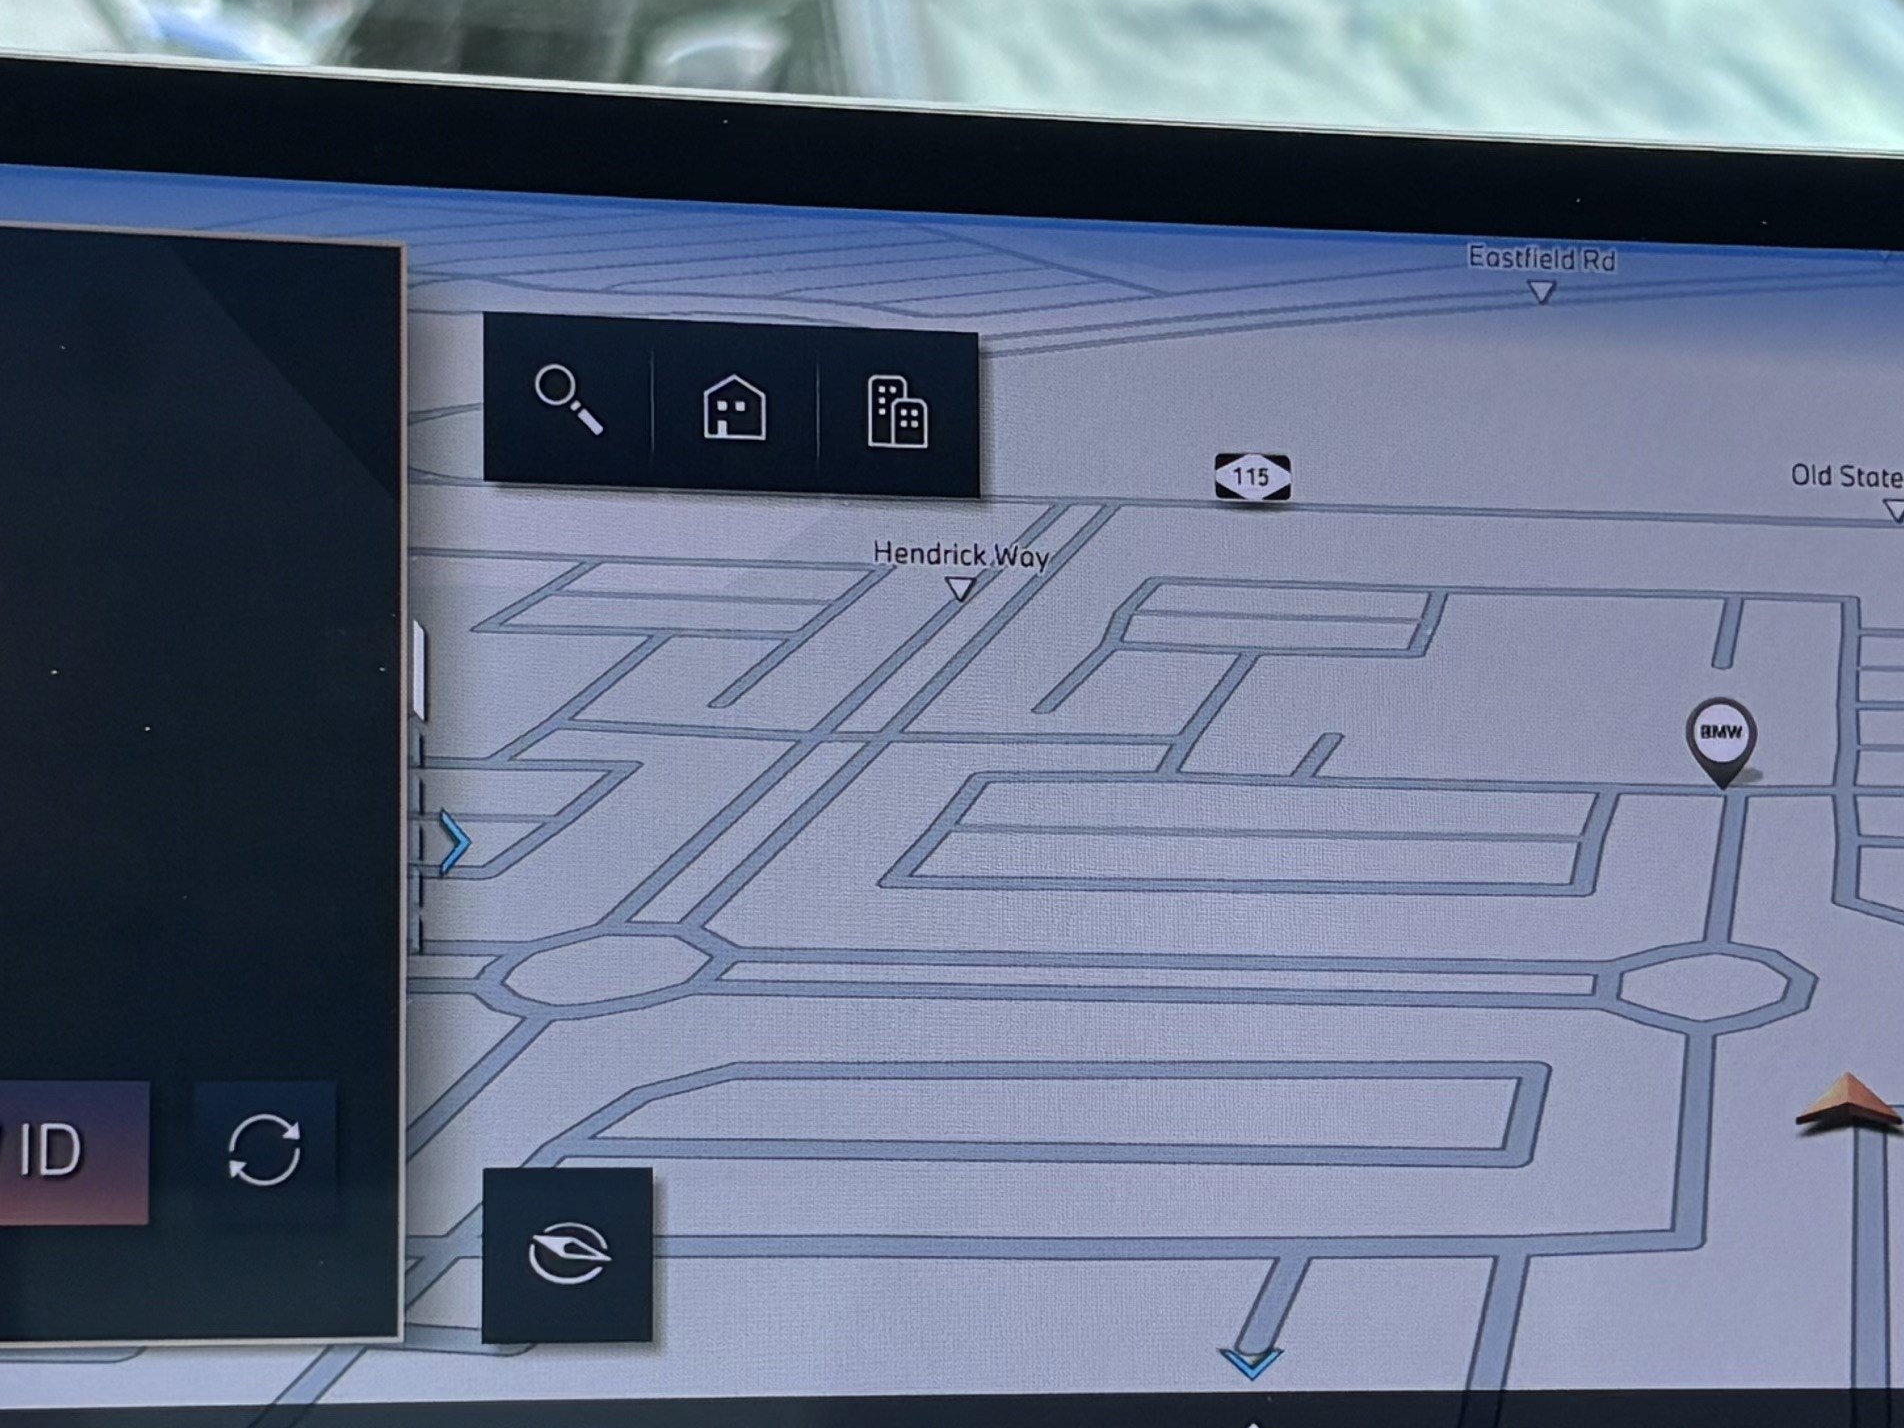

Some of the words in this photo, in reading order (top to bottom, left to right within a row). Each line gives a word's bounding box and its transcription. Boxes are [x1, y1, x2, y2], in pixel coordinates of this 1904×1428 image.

[1469, 244, 1575, 270] Eastfield
[1583, 249, 1616, 272] Rd
[1233, 466, 1269, 487] 115
[1791, 462, 1833, 487] Old
[874, 539, 987, 567] Hendrick
[994, 543, 1050, 574] Way
[1700, 724, 1743, 740] BMW
[20, 1122, 83, 1176] ID
